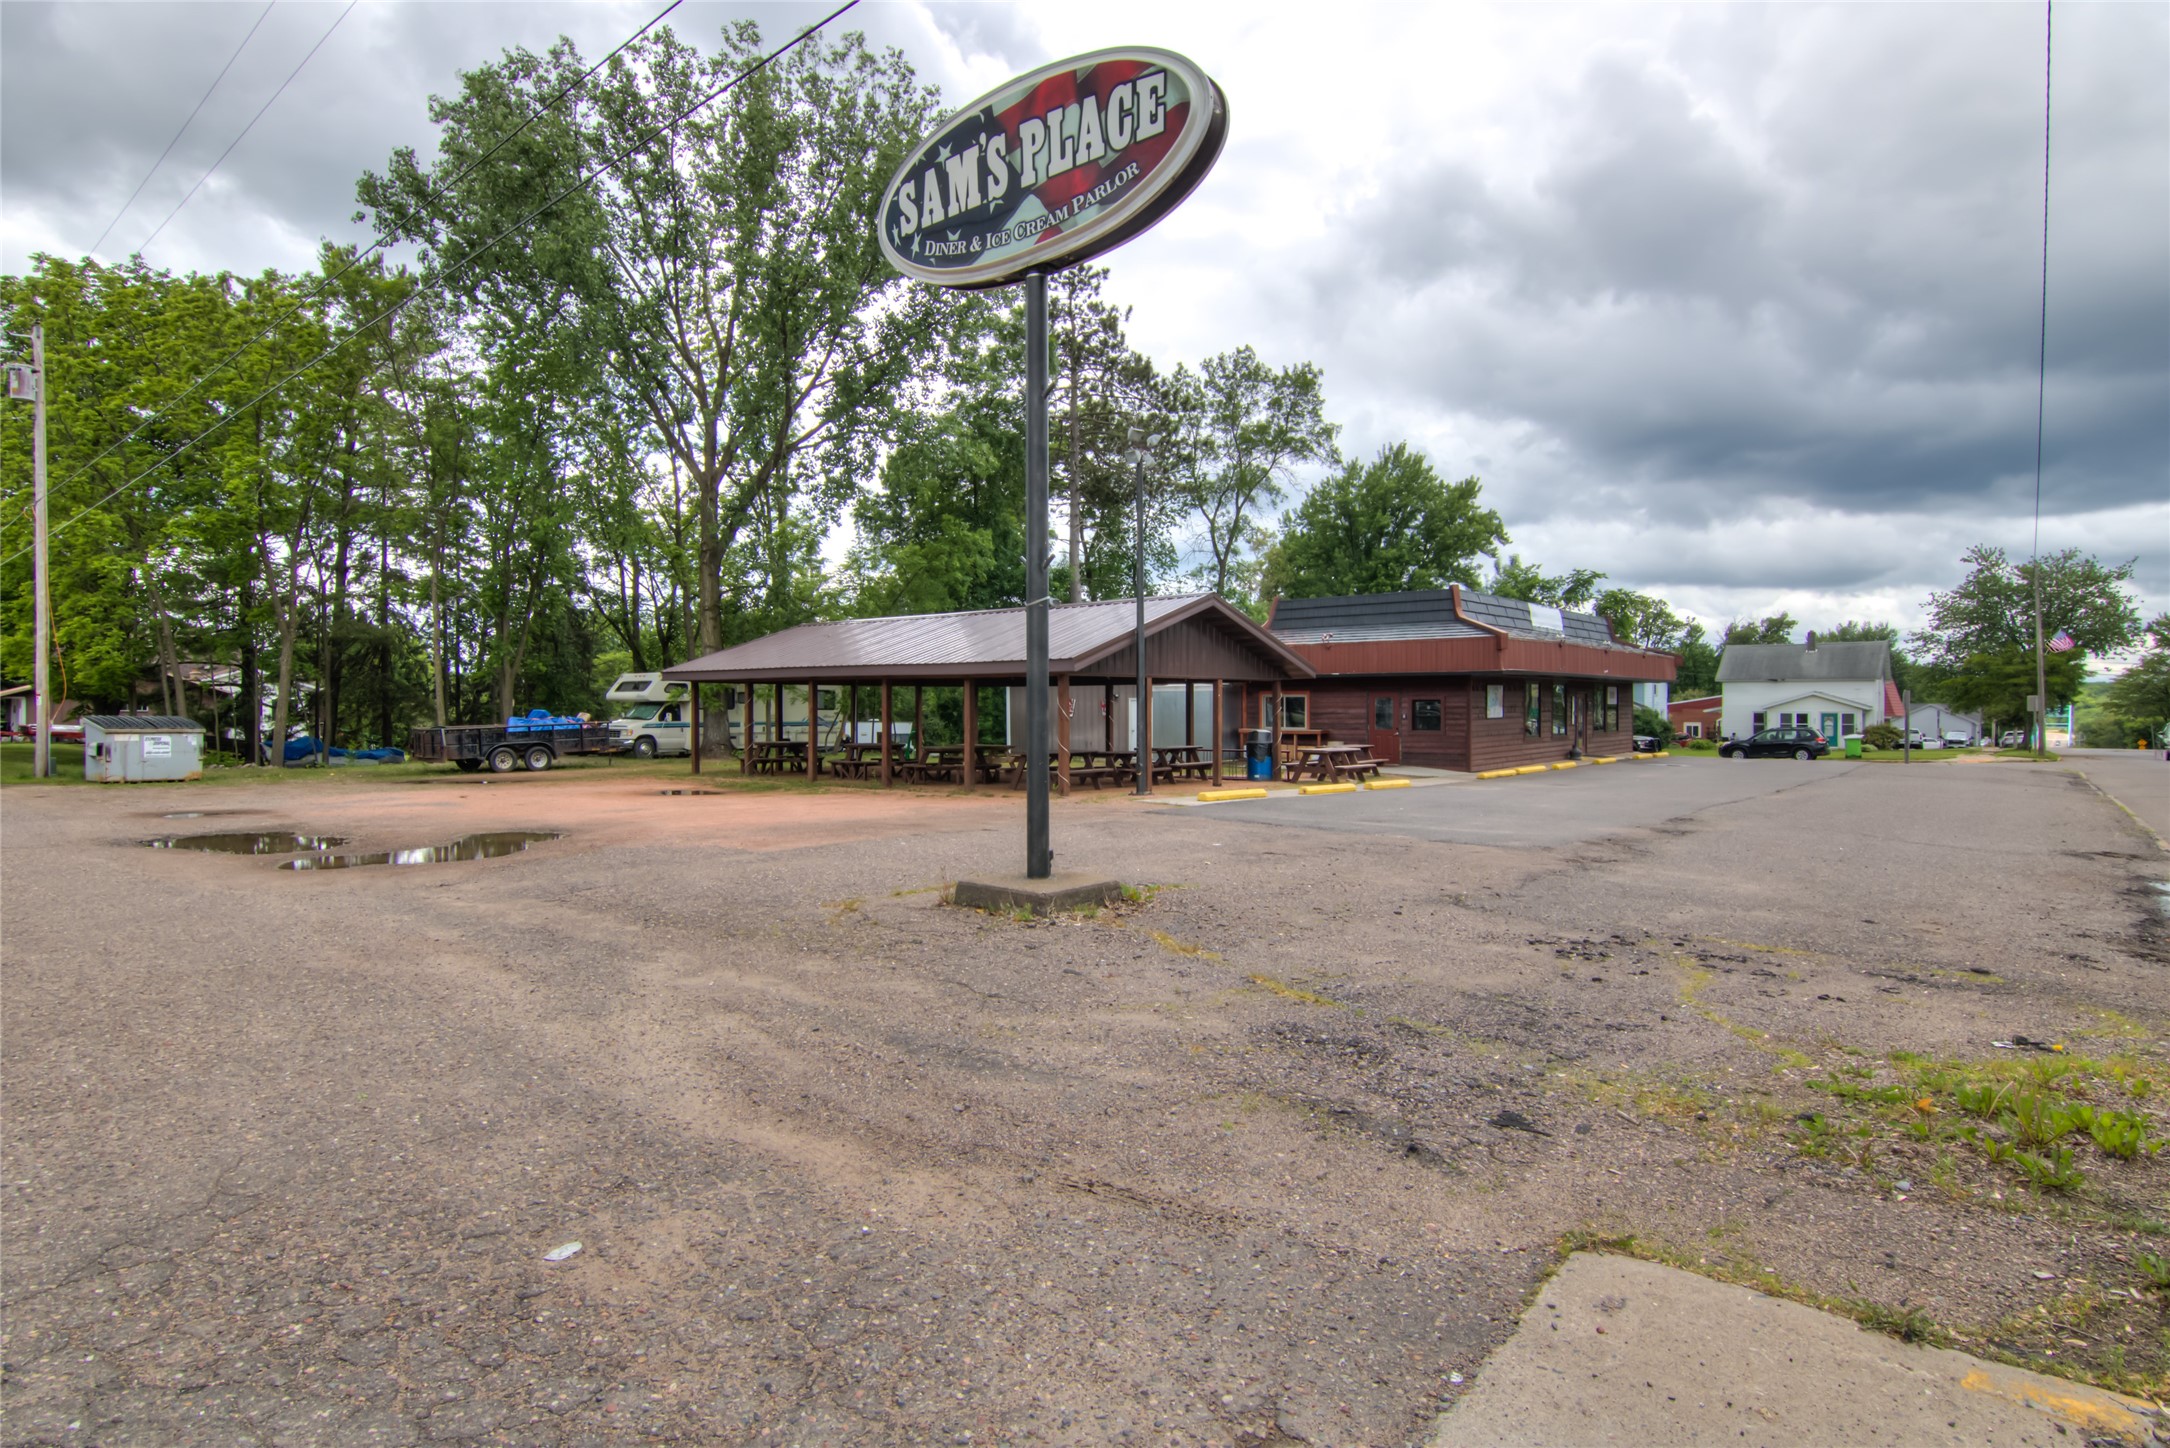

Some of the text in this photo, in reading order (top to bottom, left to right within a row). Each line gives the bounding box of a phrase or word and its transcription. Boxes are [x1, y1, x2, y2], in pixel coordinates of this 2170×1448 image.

[898, 71, 1165, 237] SAM'S PLACE
[924, 161, 1141, 256] DINER & ICE CREAM PARLOR
